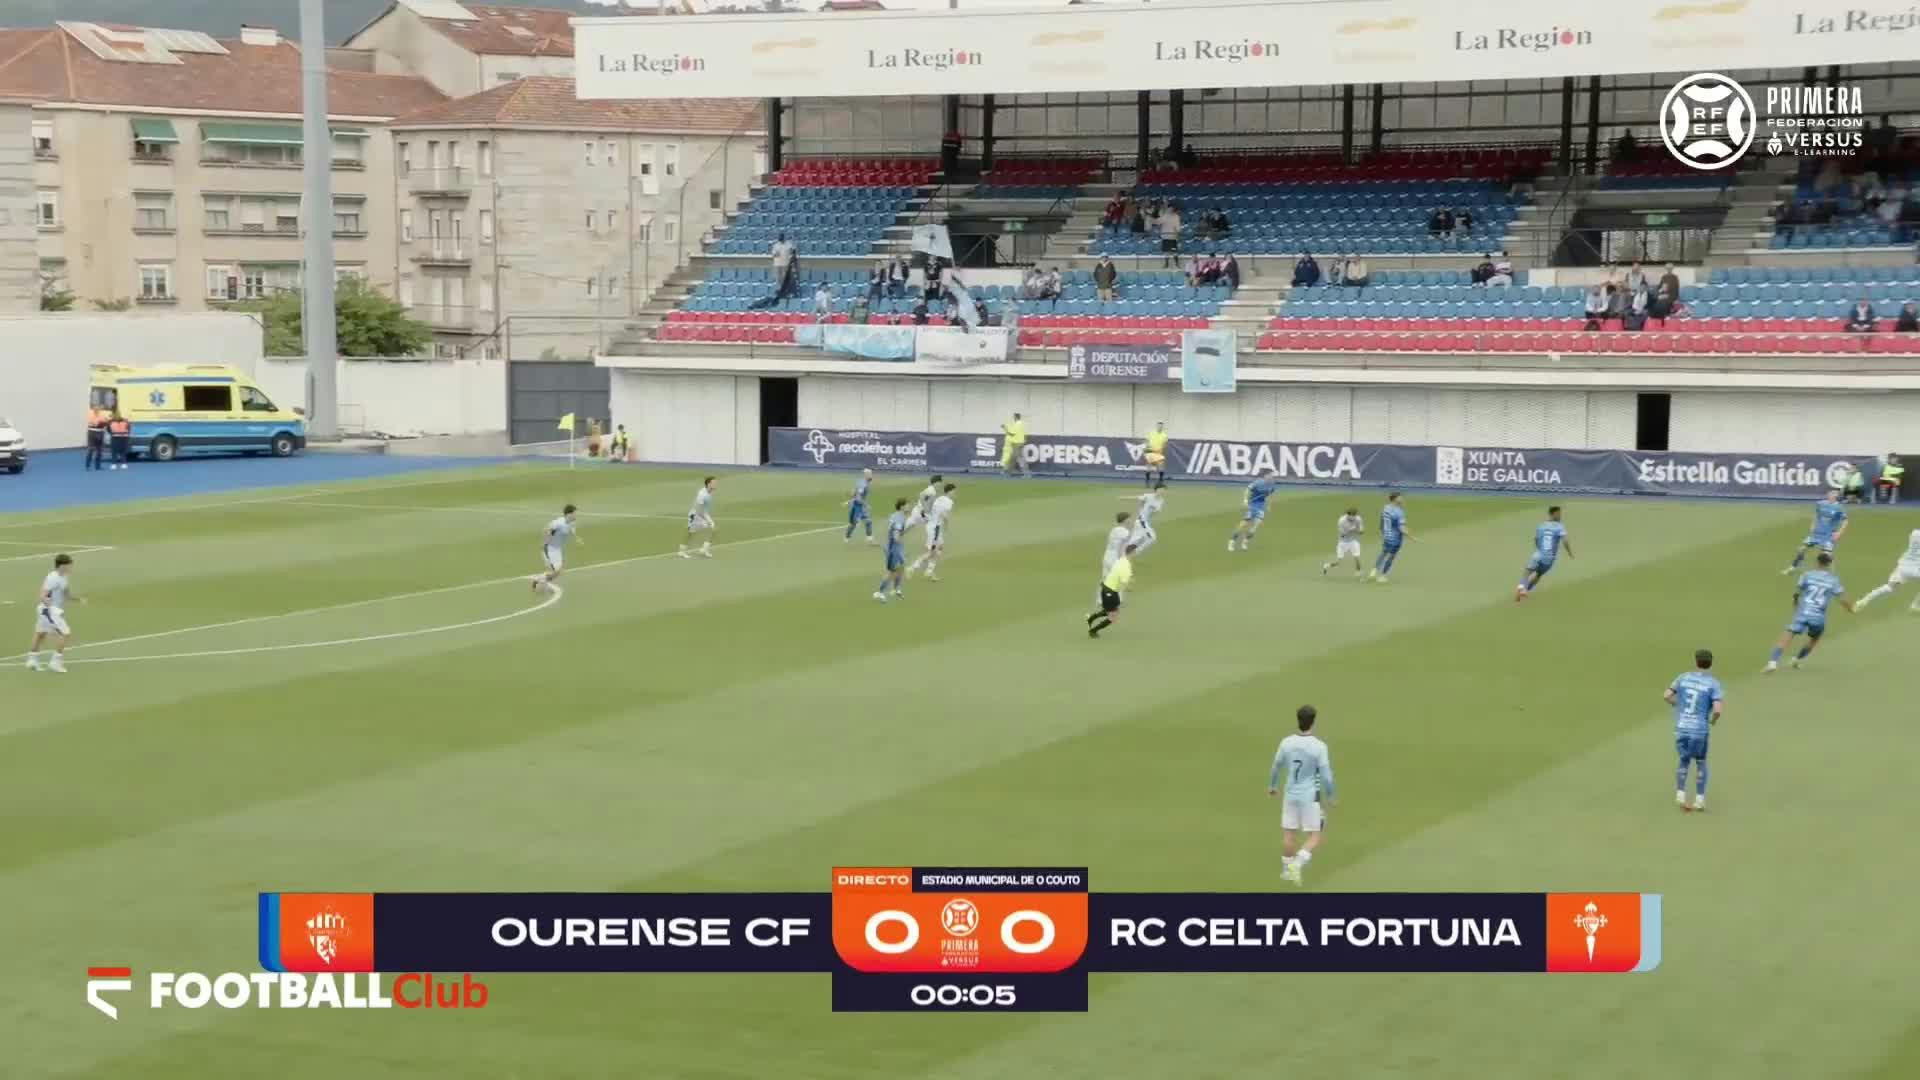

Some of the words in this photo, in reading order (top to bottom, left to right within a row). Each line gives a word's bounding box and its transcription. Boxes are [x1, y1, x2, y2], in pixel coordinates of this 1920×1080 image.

[1794, 14, 1834, 34] La
[1844, 6, 1920, 33] Regi
[1454, 30, 1489, 51] La
[867, 49, 897, 68] La
[1154, 41, 1187, 61] La
[598, 54, 627, 73] La
[1091, 350, 1169, 364] DEPUTACIÓN
[1091, 364, 1148, 378] OURENSE
[896, 442, 927, 456] salud
[1019, 443, 1112, 466] OPERSA
[1467, 451, 1526, 466] XUNTA
[877, 457, 888, 466] EL
[890, 457, 927, 467] CARMEN
[1467, 468, 1489, 482] DE
[1493, 469, 1561, 484] GALICIA
[1637, 459, 1730, 484] Estrella
[1733, 460, 1821, 487] Galicia
[1292, 759, 1303, 784] 7
